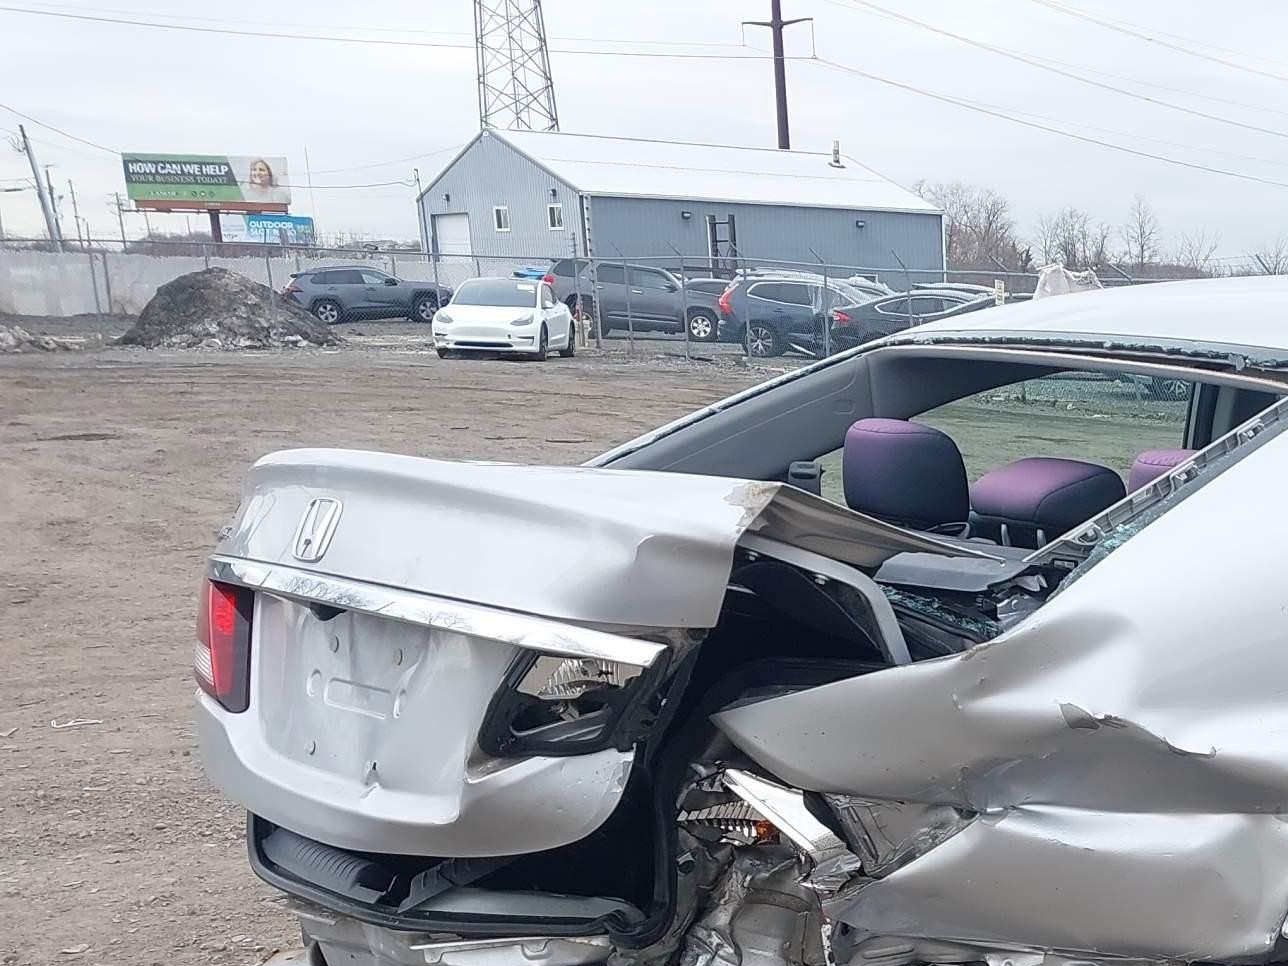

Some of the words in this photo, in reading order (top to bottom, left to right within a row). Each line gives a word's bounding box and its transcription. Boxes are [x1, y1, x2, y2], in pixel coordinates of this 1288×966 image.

[128, 162, 156, 174] HOW
[157, 163, 181, 175] CAN
[182, 164, 201, 175] WE
[202, 164, 229, 176] HELP
[130, 174, 153, 182] YOUR
[155, 175, 194, 183] BUSINESS
[194, 176, 228, 184] TODAY?
[249, 220, 294, 229] OUTDOOR
